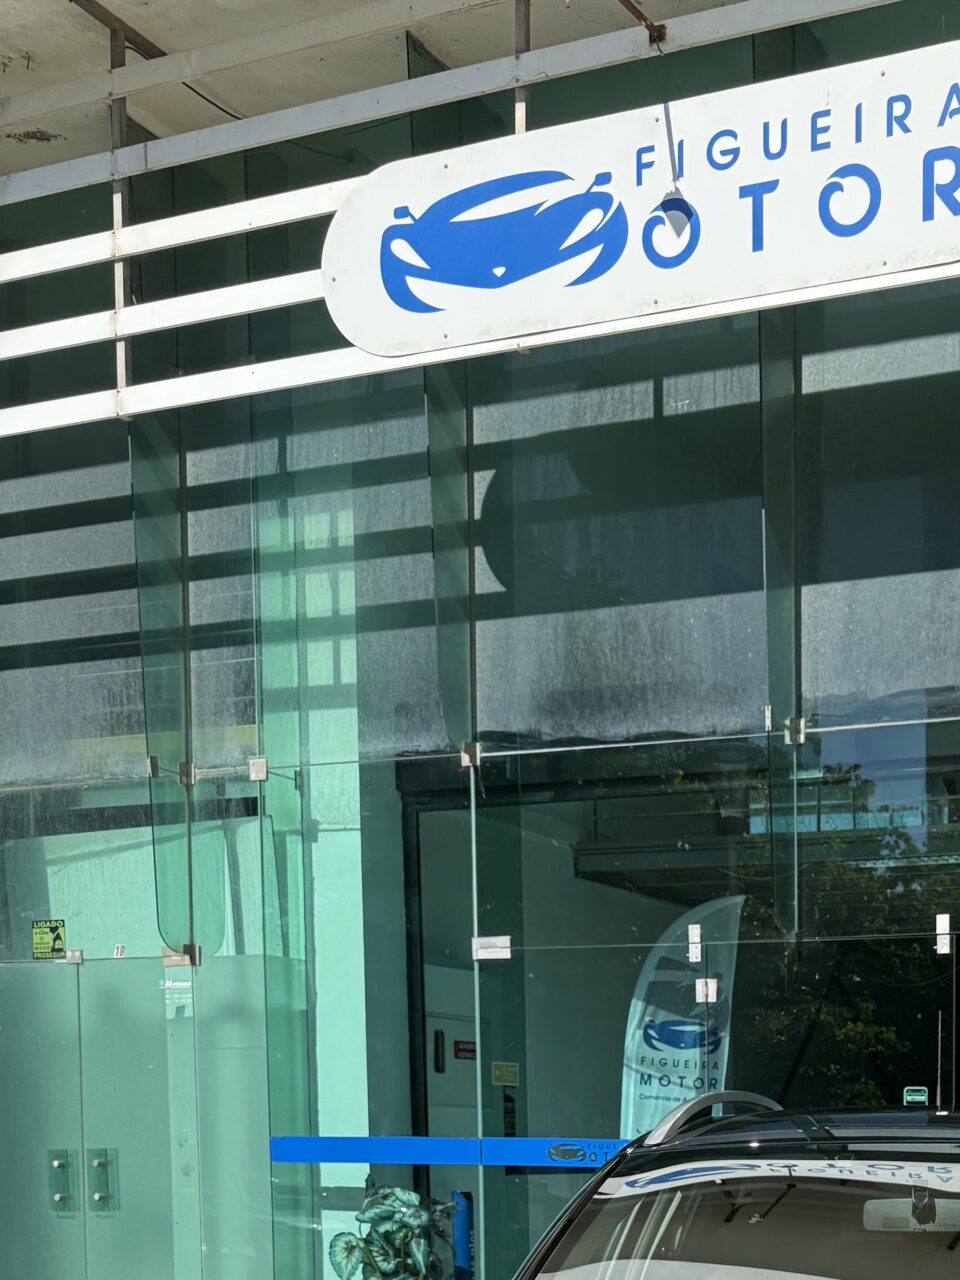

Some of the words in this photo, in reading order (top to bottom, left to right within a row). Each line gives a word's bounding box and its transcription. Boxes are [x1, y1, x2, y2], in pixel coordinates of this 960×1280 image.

[33, 920, 63, 928] LIGADO
[640, 1056, 720, 1071] FIGUEIRA
[640, 1073, 718, 1090] MOTOR
